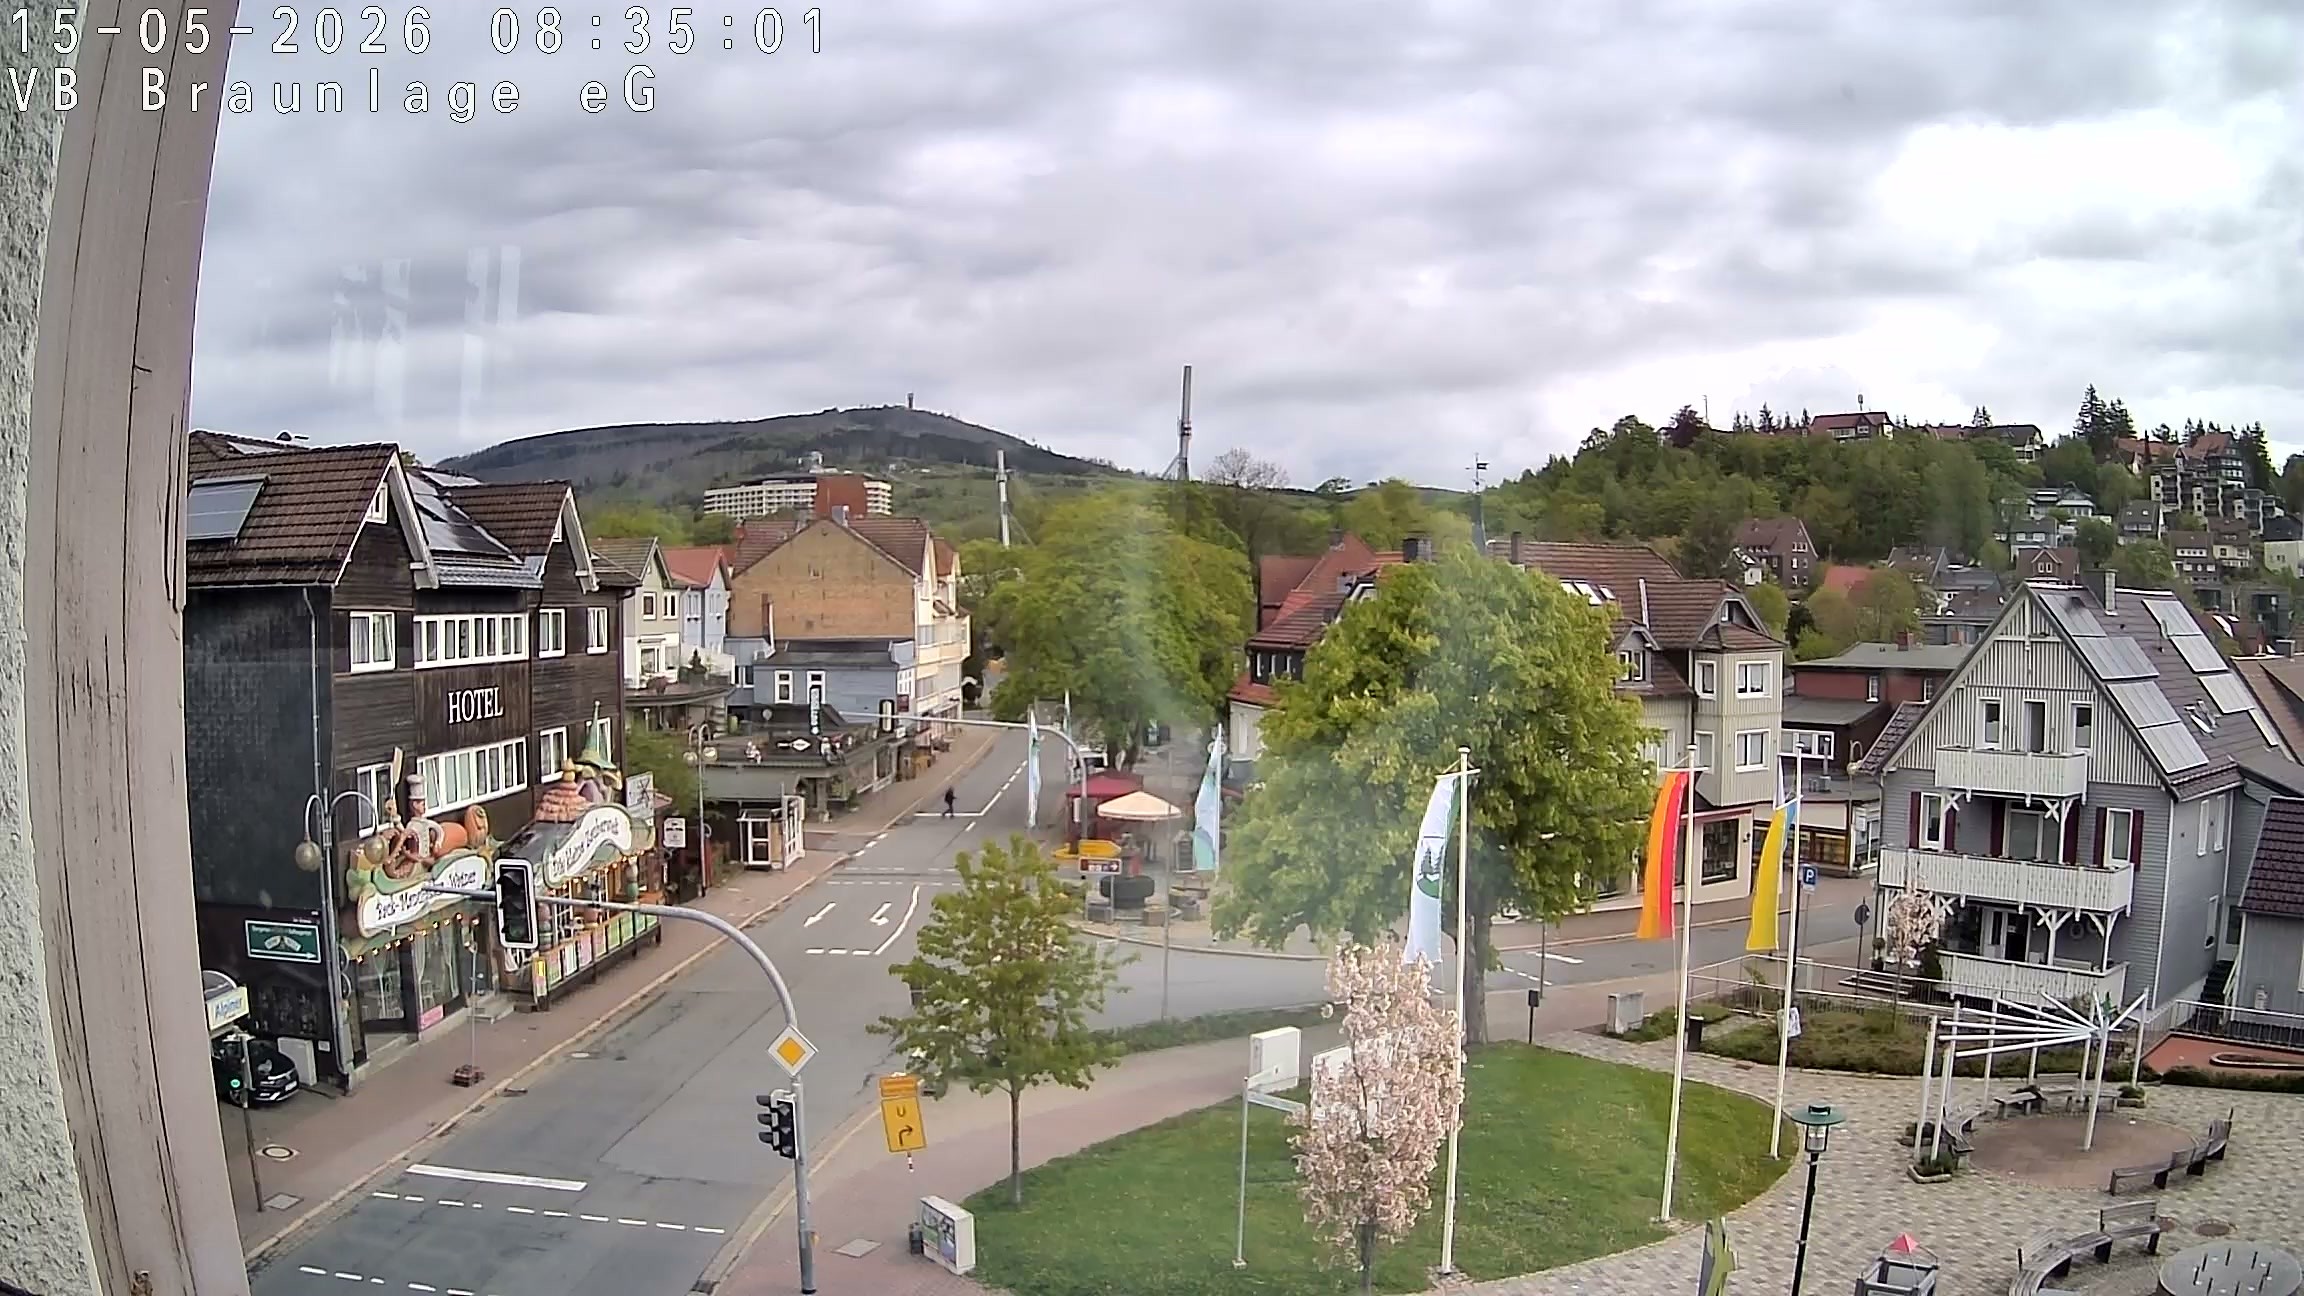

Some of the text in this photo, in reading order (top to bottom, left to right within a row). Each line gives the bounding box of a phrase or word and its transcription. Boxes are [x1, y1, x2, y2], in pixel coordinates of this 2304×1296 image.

[447, 686, 504, 724] HOTEL
[1806, 869, 1814, 882] P
[896, 1105, 906, 1117] U
